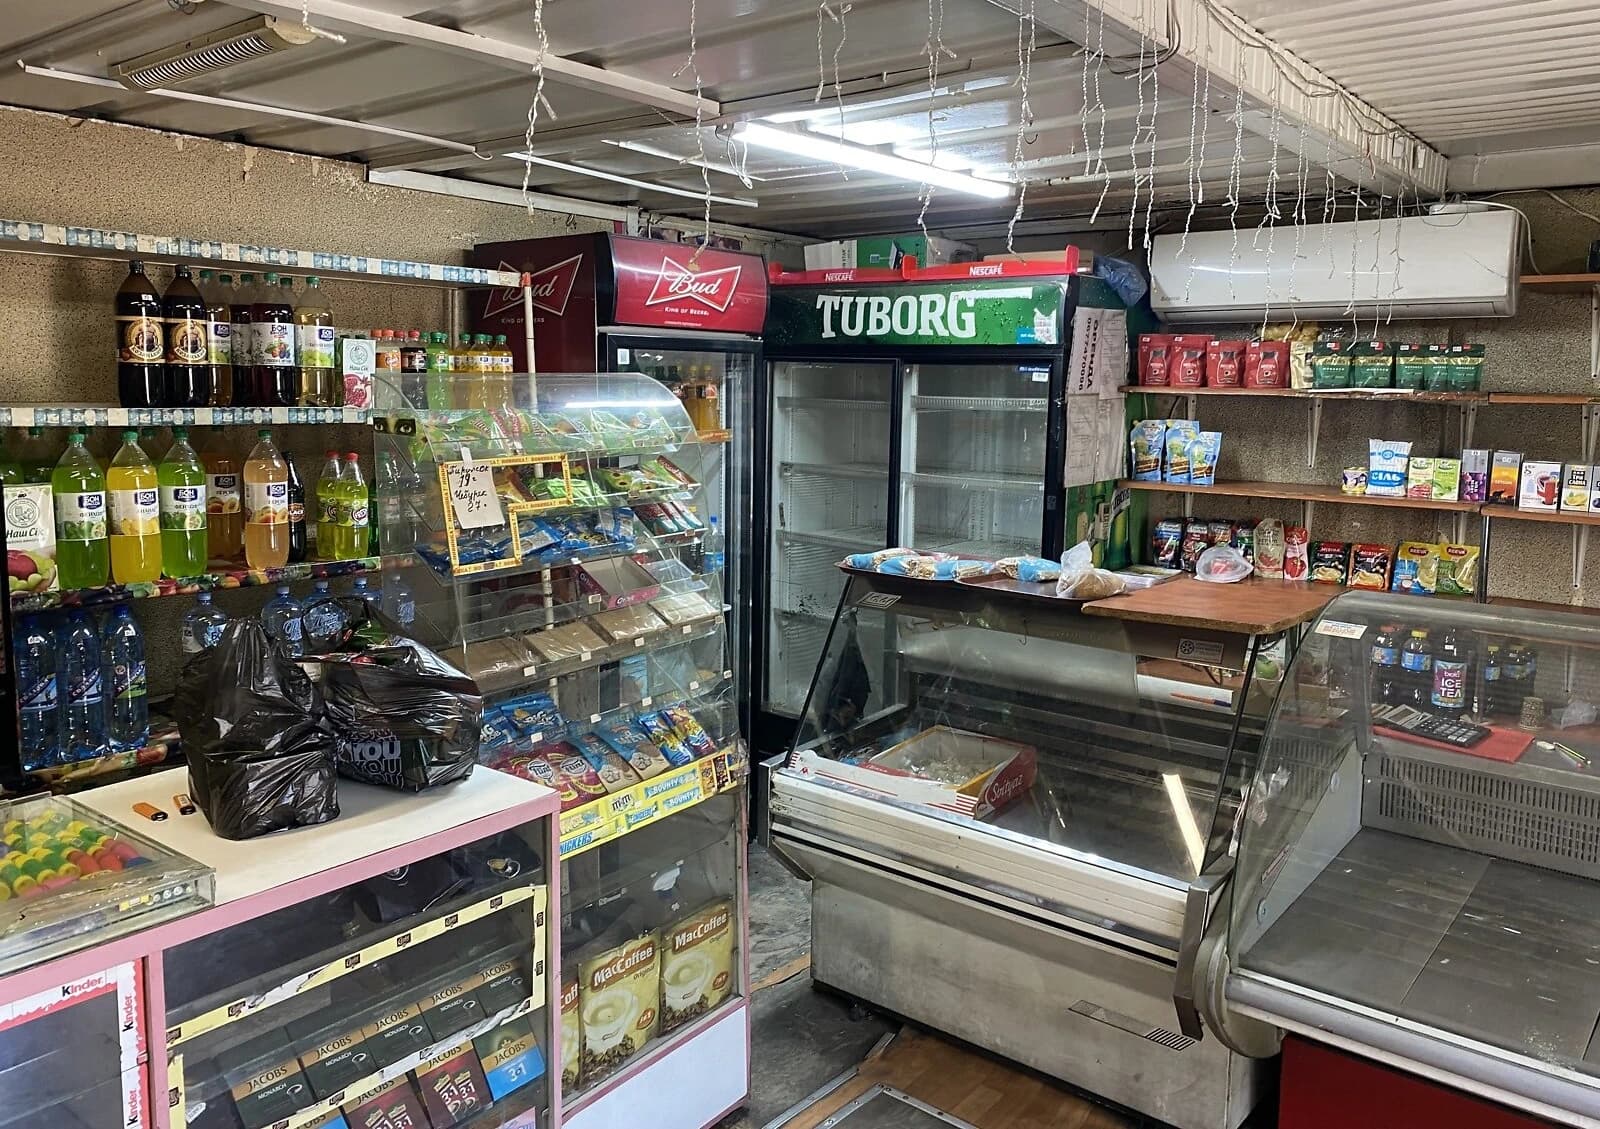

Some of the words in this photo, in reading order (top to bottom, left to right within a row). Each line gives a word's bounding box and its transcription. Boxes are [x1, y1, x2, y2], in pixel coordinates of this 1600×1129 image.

[825, 270, 854, 282] NESCAFÉ
[969, 262, 1003, 276] NESCAFÉ
[666, 271, 723, 295] Bud
[816, 294, 976, 339] TUBORG
[271, 324, 287, 332] БОН
[1087, 319, 1099, 389] ОРЕНДА
[6, 529, 28, 539] Наш
[1440, 687, 1462, 699] TEA
[1441, 677, 1462, 689] ICE
[652, 778, 680, 794] BOUNTY
[668, 791, 696, 806] BOUNTY
[559, 832, 593, 855] NICKERS
[674, 910, 729, 950] MacCoffee
[480, 962, 512, 982] JACOBS
[592, 944, 655, 988] MacCoffee
[61, 976, 103, 998] Kinder
[490, 975, 512, 988] MONARCH
[431, 984, 463, 1005] JACOBS
[440, 998, 464, 1012] MONARCH
[122, 994, 135, 1032] Kinder
[374, 1008, 409, 1031] JACOBS
[384, 1024, 409, 1039] MONARCH
[315, 1035, 353, 1059] JACOBS
[427, 1046, 463, 1069] JACOBS
[494, 1042, 527, 1066] JACOBS
[325, 1051, 353, 1067] MONARCH
[247, 1065, 288, 1092] JACOBS
[257, 1082, 287, 1100] MONARCH
[126, 1089, 138, 1127] Kinder
